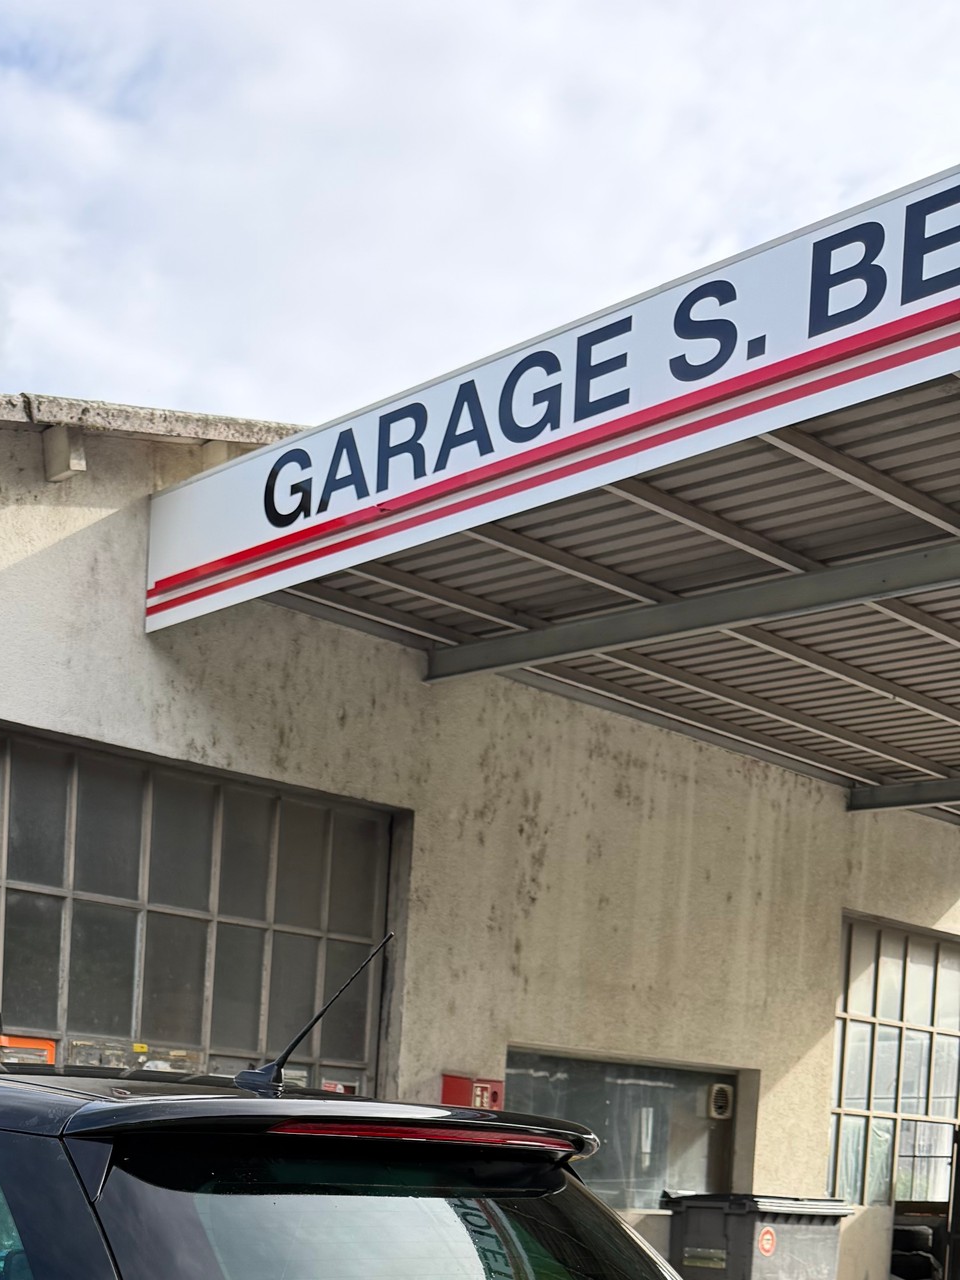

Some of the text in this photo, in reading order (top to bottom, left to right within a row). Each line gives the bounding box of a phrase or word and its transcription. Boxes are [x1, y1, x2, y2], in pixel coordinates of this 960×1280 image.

[263, 184, 960, 528] GARAGE S. BE
